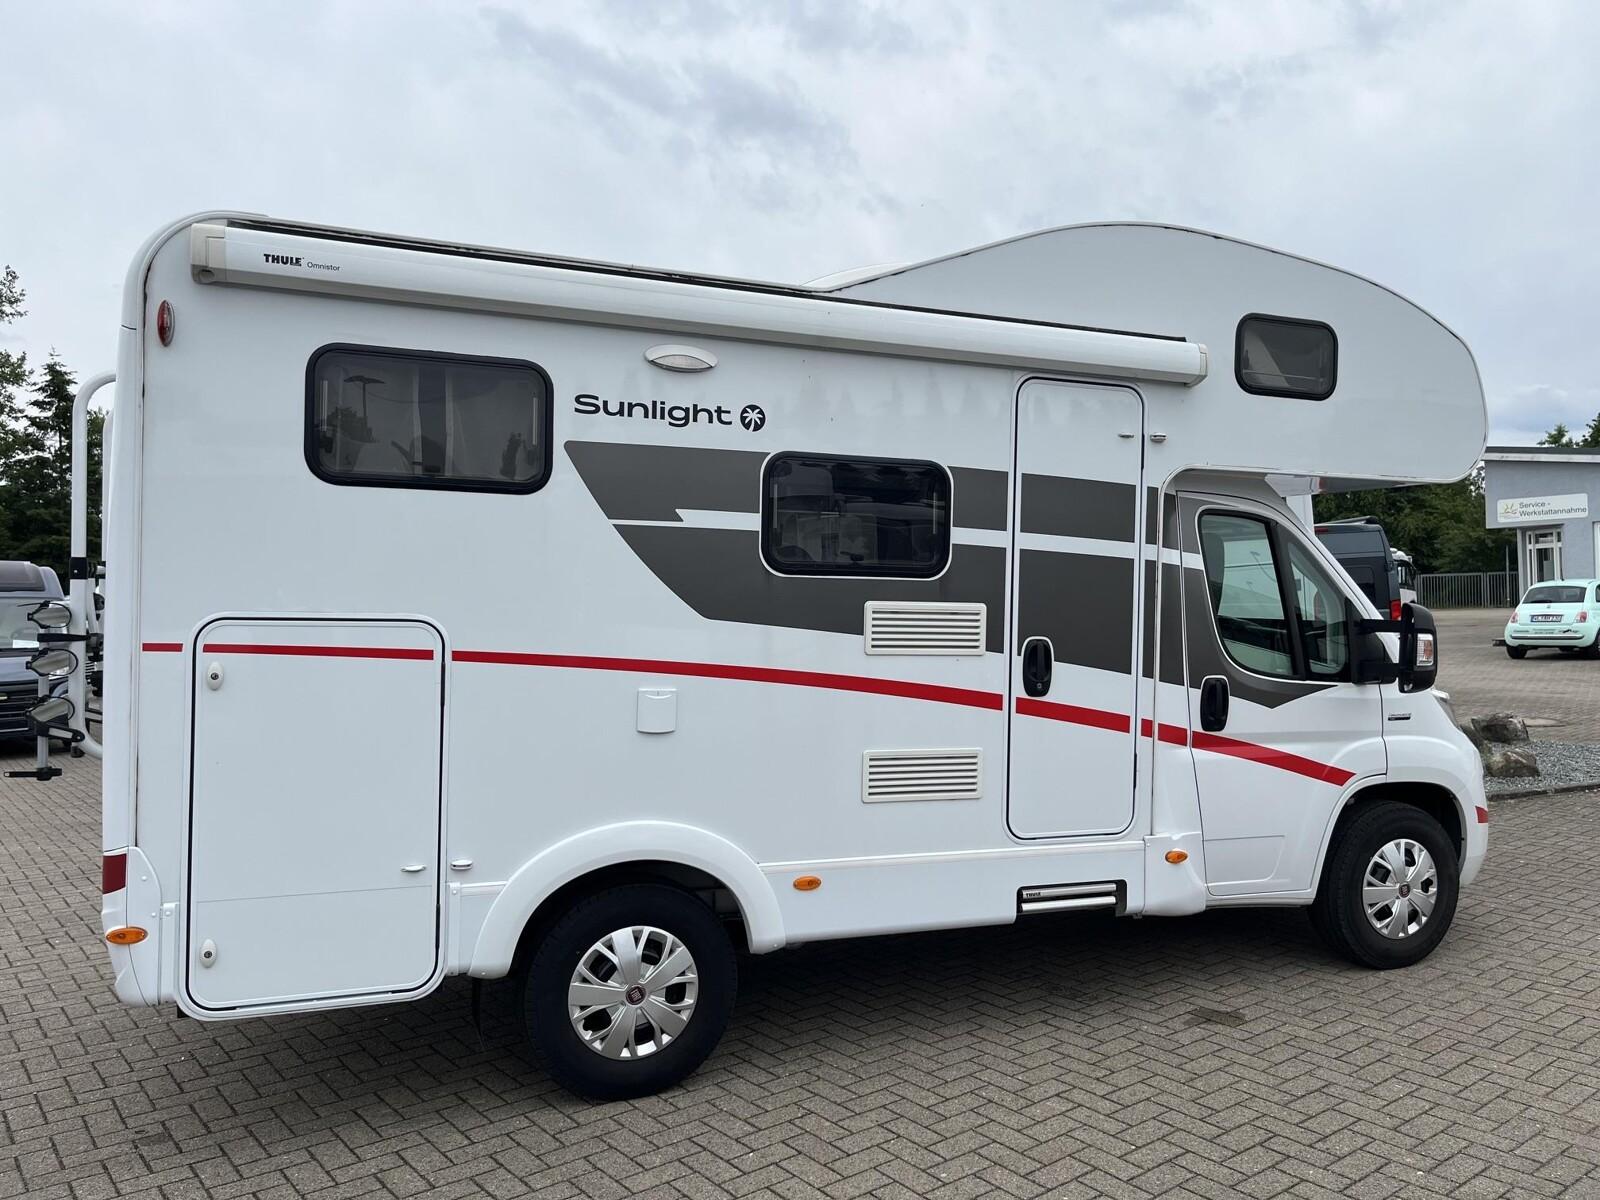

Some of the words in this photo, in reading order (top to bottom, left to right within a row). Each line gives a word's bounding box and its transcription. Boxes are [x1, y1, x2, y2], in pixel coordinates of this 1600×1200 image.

[263, 253, 303, 267] THULE
[306, 261, 341, 271] Omnistor
[574, 393, 733, 428] Sunlight
[1519, 506, 1587, 517] Werkstattannahme
